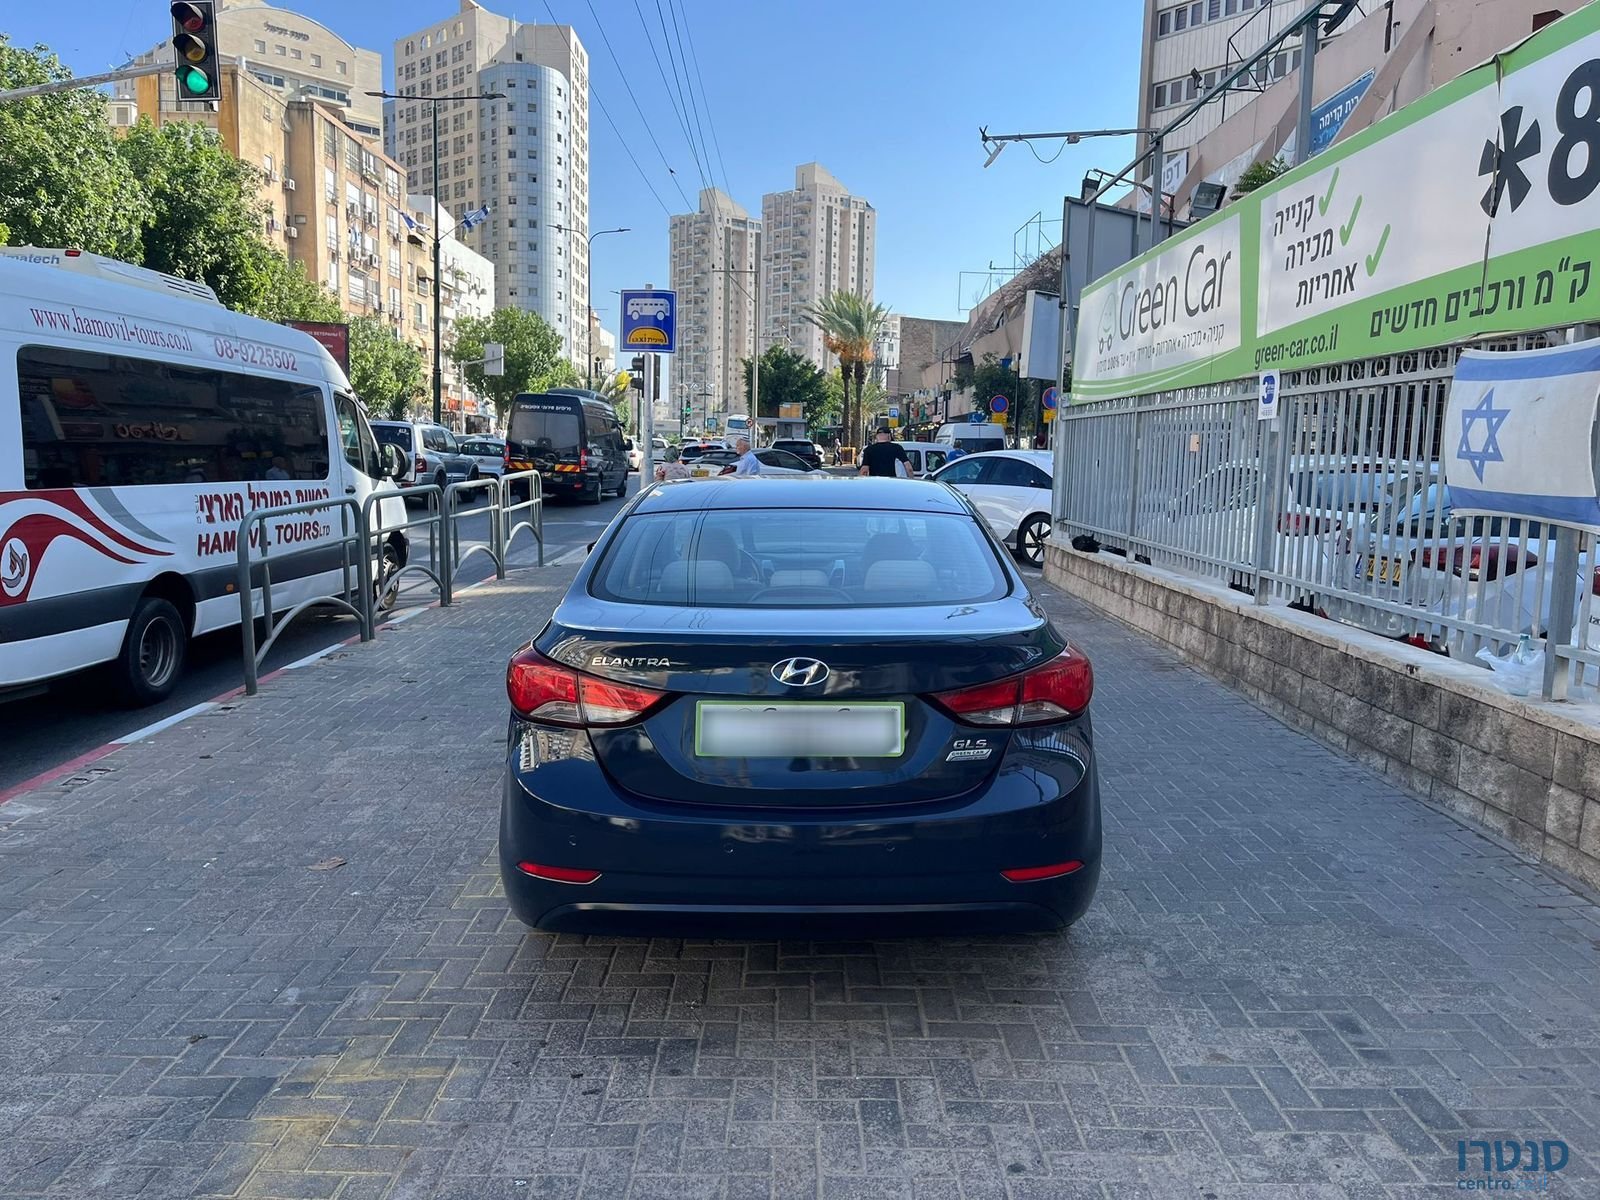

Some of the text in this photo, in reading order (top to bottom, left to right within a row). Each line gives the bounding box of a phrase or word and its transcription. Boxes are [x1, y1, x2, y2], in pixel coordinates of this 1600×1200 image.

[1319, 104, 1343, 130] קדימה
[1274, 195, 1315, 237] קנייה
[1285, 228, 1334, 271] מכירה
[1119, 244, 1232, 341] Green Car
[1295, 262, 1358, 308] אחריות
[1444, 275, 1526, 323] ורכבים
[30, 308, 193, 352] www.hamovil-tours.co.il
[1207, 323, 1225, 343] קניה
[1369, 297, 1438, 338] חדשים
[214, 336, 298, 371] 08-9225502
[1181, 330, 1202, 350] מכירה
[1254, 323, 1339, 370] green-car.co.il
[199, 491, 245, 524] הארצי
[197, 520, 331, 557] HAMV TOURS LTD
[591, 656, 670, 667] ELANTRA
[953, 739, 988, 750] GLS
